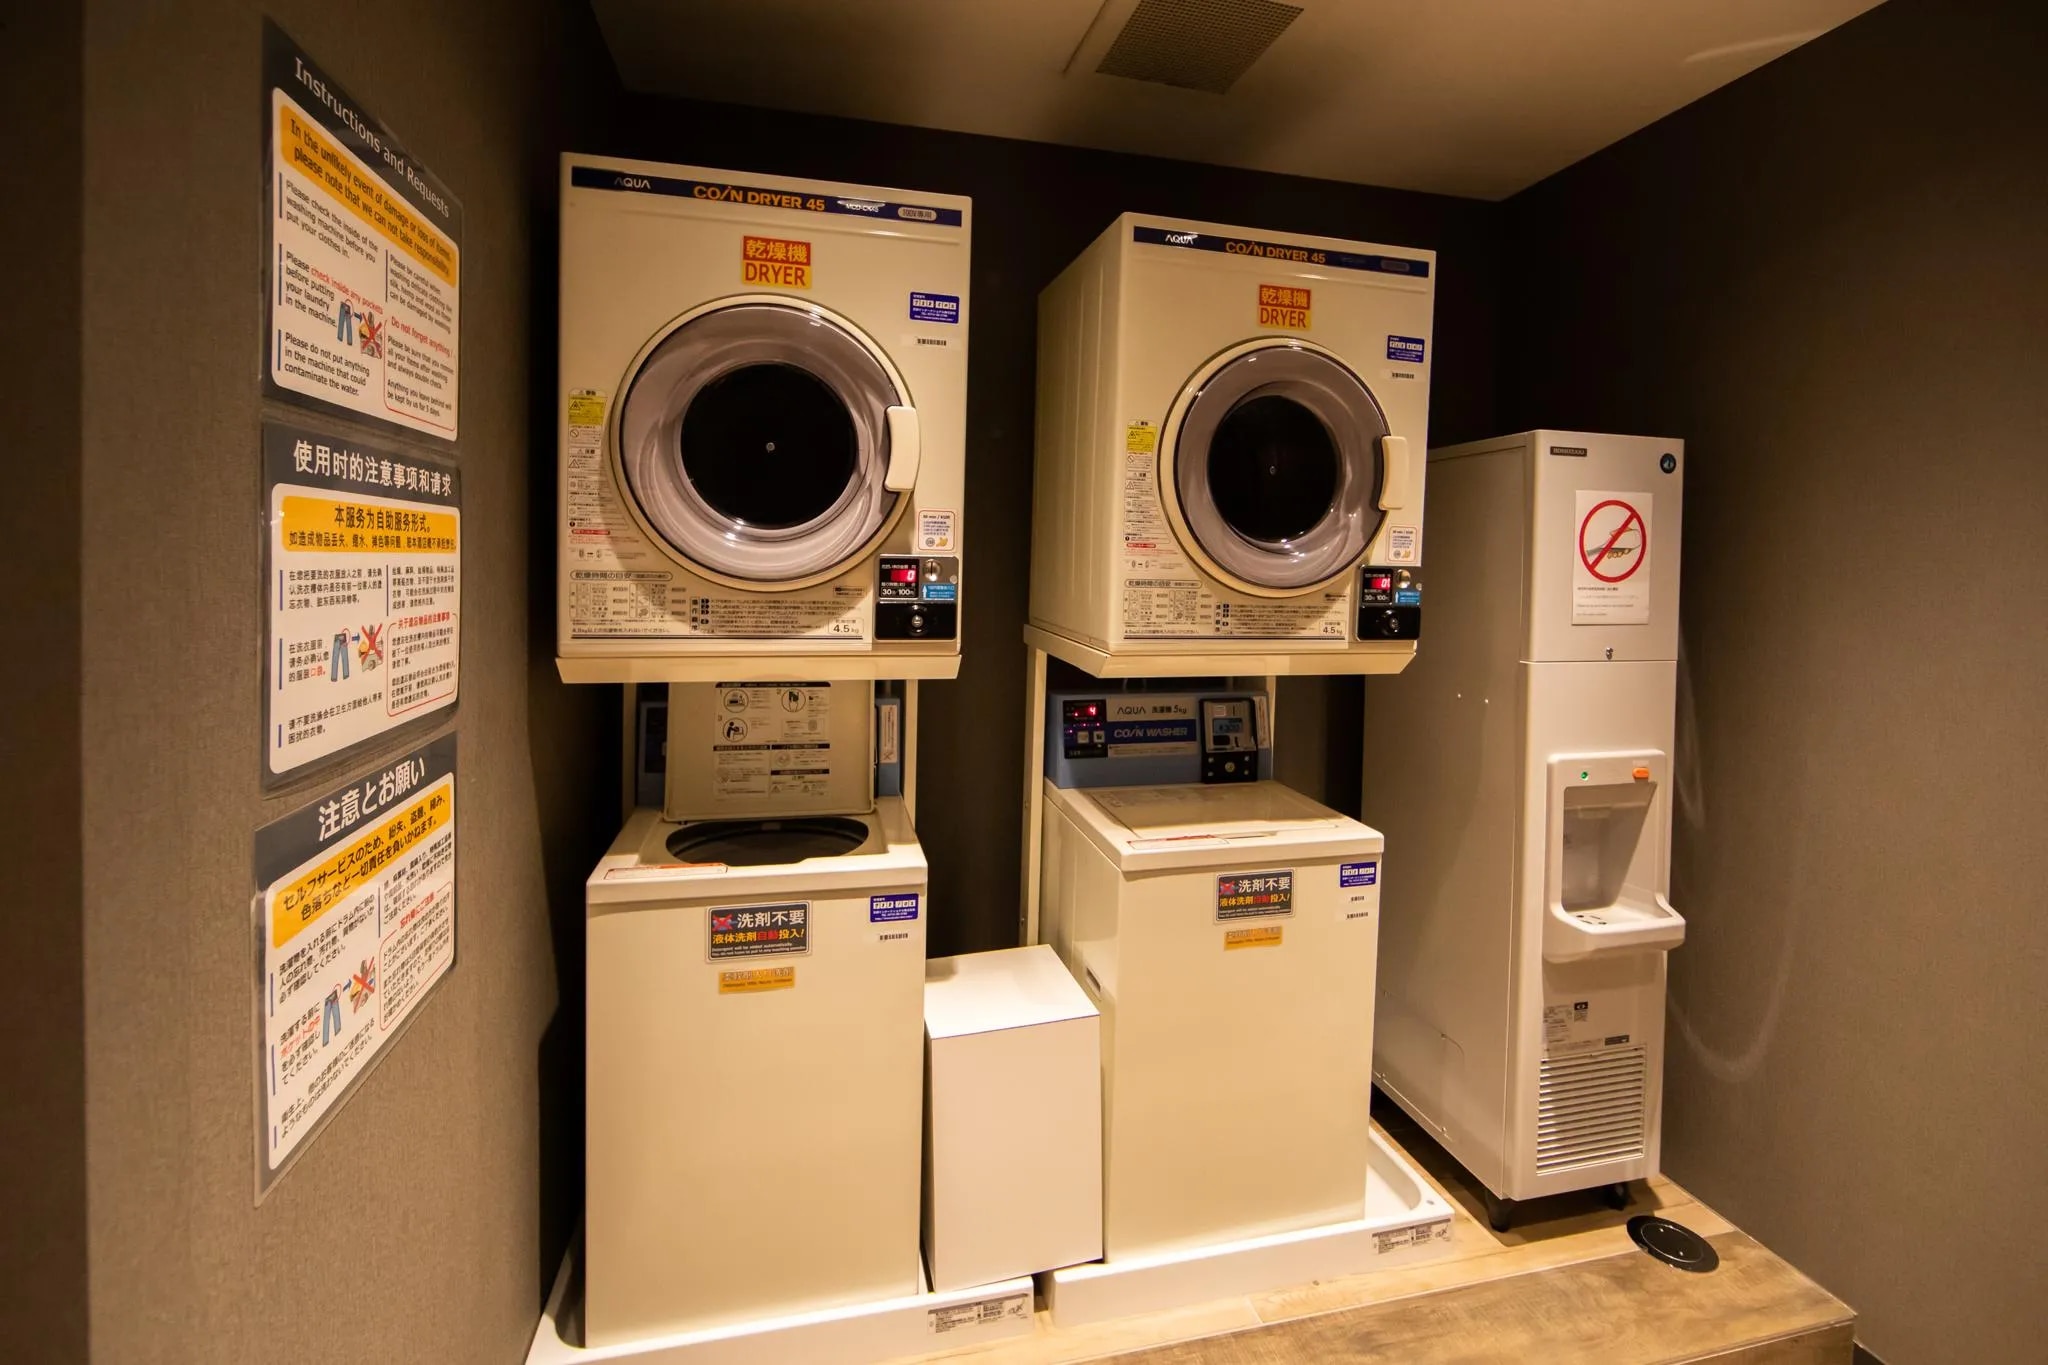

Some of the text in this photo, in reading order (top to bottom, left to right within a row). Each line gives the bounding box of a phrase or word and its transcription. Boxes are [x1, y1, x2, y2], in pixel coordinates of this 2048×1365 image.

[295, 54, 448, 222] Instructions and Requests
[290, 117, 301, 140] In
[304, 128, 318, 155] the
[320, 142, 350, 185] unlikely
[353, 171, 373, 199] event
[375, 189, 382, 207] of
[383, 197, 408, 230] damage
[409, 220, 415, 233] or
[614, 177, 650, 190] AQUA
[294, 143, 413, 249] please note that we can not take
[746, 192, 803, 210] DRYER
[806, 198, 826, 212] 45
[286, 178, 309, 204] Please
[311, 197, 329, 219] check
[331, 211, 341, 227] the
[343, 220, 360, 241] inside
[368, 238, 377, 253] the
[286, 195, 375, 265] washing machine before you
[286, 209, 299, 227] put
[301, 219, 316, 239] your
[318, 230, 340, 253] clothes
[745, 240, 808, 263] 乾燥機
[1165, 233, 1196, 245] AQUA
[286, 250, 309, 273] Please
[311, 265, 329, 285] check
[1266, 247, 1309, 262] DRYER
[1311, 252, 1326, 264] 45
[286, 264, 334, 302] before putting
[745, 262, 806, 287] DRYER
[285, 280, 329, 312] your laundry
[1260, 287, 1309, 308] 乾燥機
[294, 298, 306, 313] the
[308, 305, 337, 328] machine.
[1260, 306, 1307, 328] DRYER
[391, 315, 399, 329] Do
[400, 321, 410, 335] not
[411, 327, 428, 346] forget
[285, 331, 369, 377] Please do not put anything
[294, 349, 305, 364] the
[307, 355, 335, 375] machine
[336, 366, 349, 380] that
[350, 371, 365, 386] could
[284, 361, 359, 396] contaminate the water.
[293, 438, 451, 497] 使用时的注意事项和请求
[334, 503, 430, 532] 本服务为自助服务形式。
[907, 570, 916, 580] 0
[833, 624, 850, 633] 4.5
[1323, 626, 1336, 634] 4.5
[1116, 705, 1146, 715] AQUA
[1173, 704, 1187, 714] 5kg
[1146, 727, 1188, 737] WASHER
[318, 753, 425, 843] 注意とお願い
[301, 812, 436, 923] 色落ちなど一切責任を負いかねます。
[1238, 877, 1291, 893] 洗剤不要
[737, 909, 805, 928] 洗剤不要
[280, 999, 319, 1046] 洗濯する前に
[282, 1041, 318, 1089] てください。
